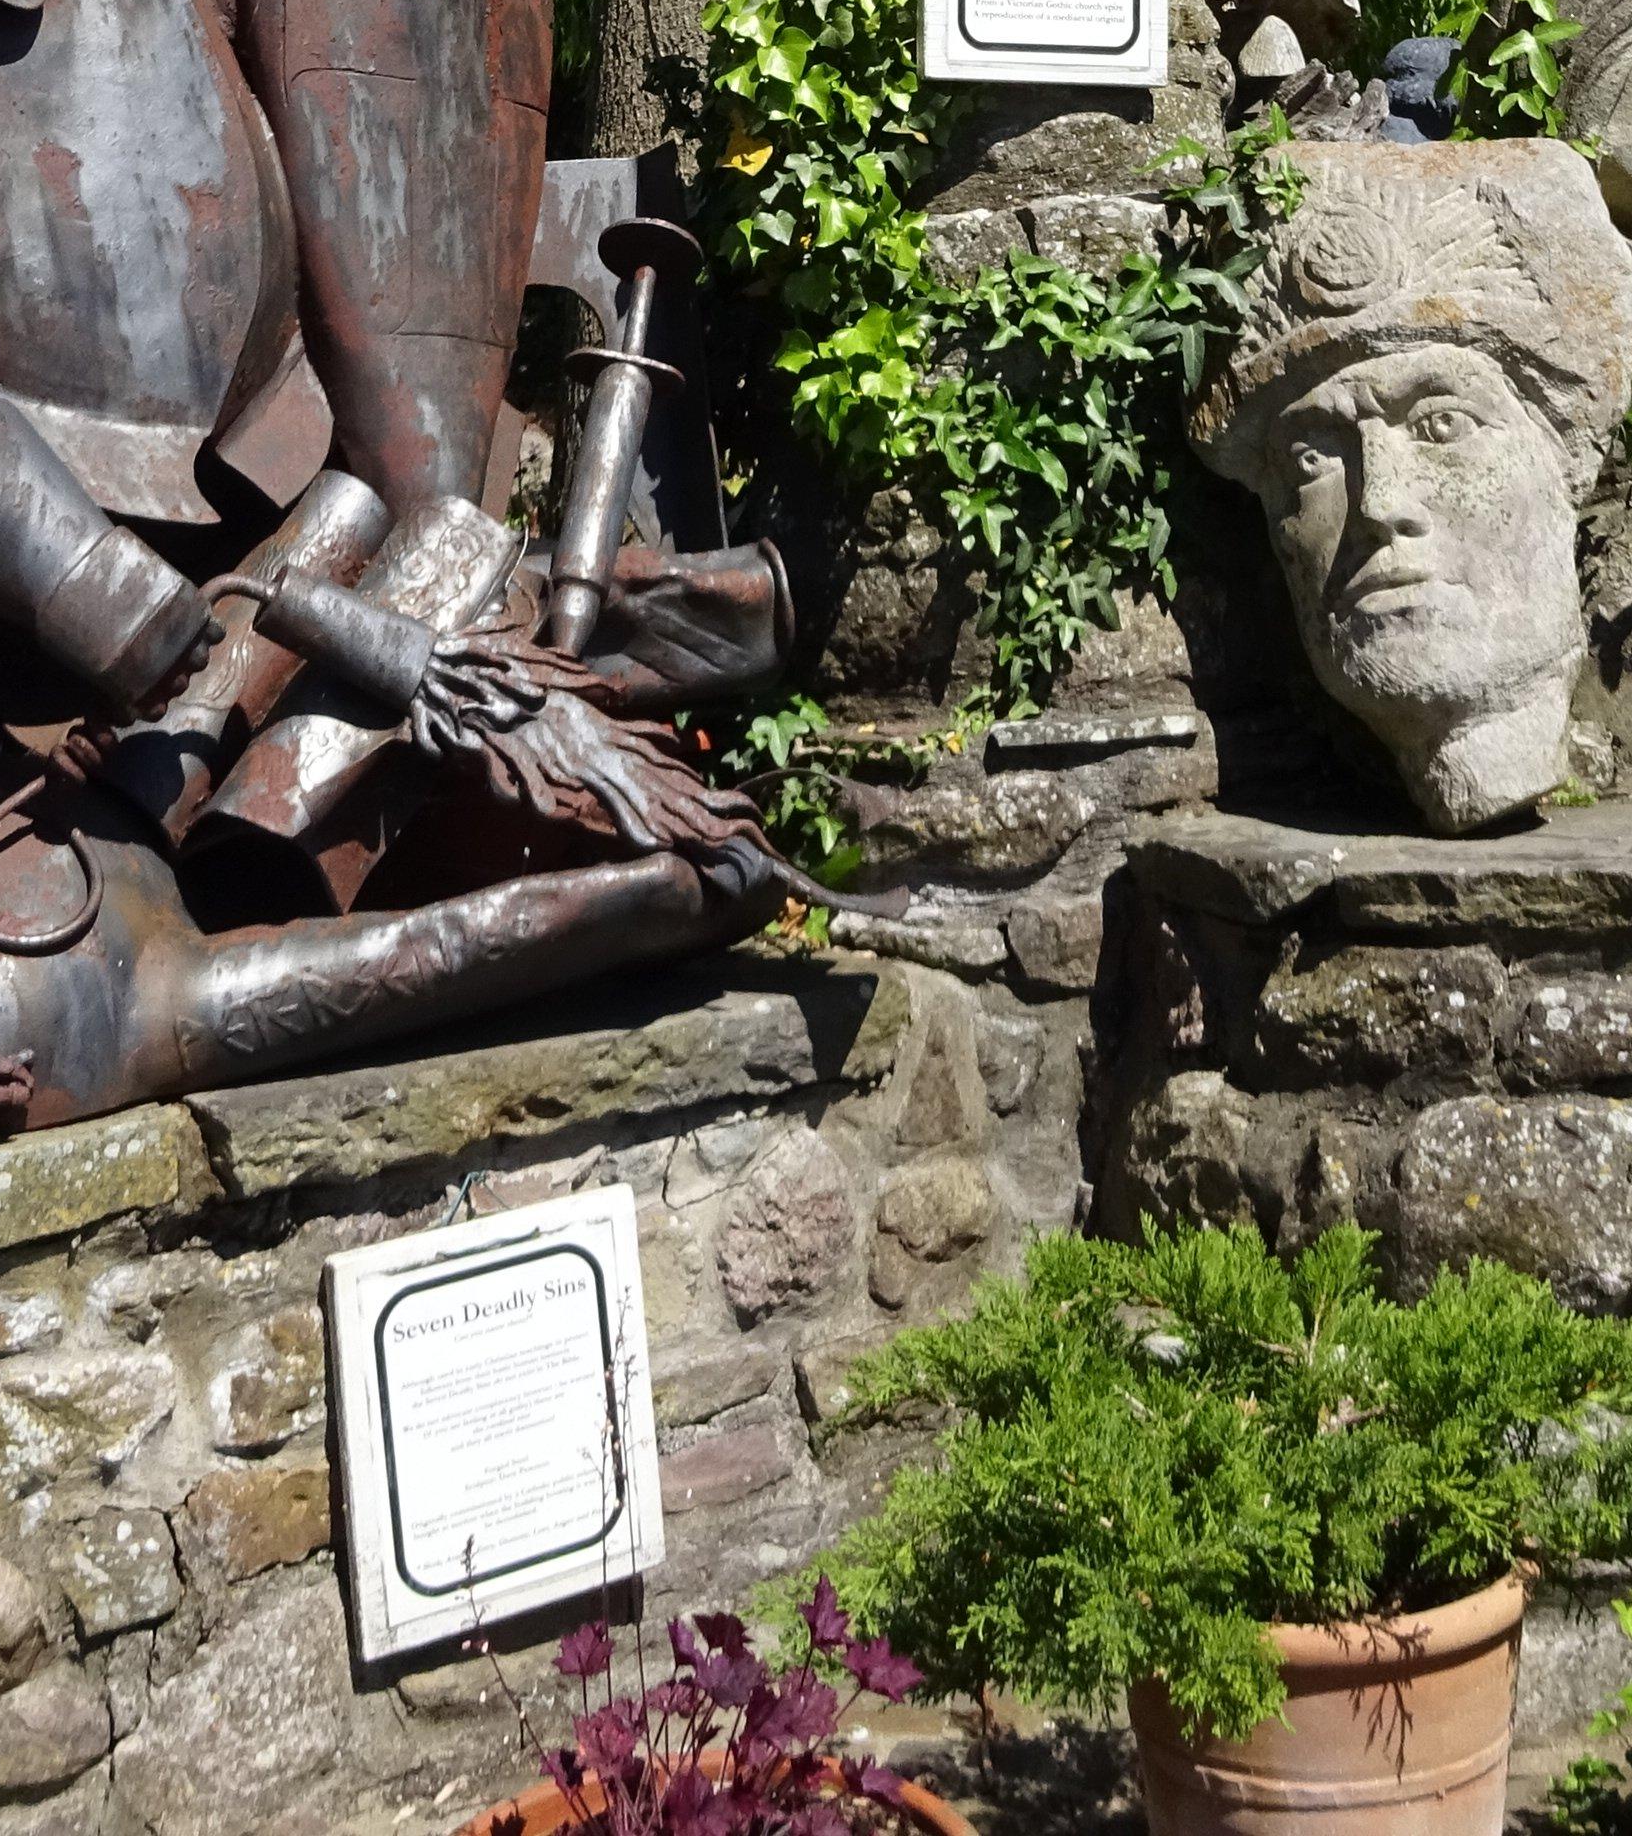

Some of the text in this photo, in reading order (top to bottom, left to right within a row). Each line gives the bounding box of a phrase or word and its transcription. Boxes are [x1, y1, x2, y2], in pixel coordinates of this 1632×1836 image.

[1045, 0, 1072, 9] Gothic
[1075, 1, 1102, 10] church
[982, 10, 1034, 20] reproduction
[1095, 14, 1125, 24] original
[393, 1315, 453, 1342] Seven
[463, 1289, 535, 1322] Deadly
[544, 1279, 585, 1299] Sins
